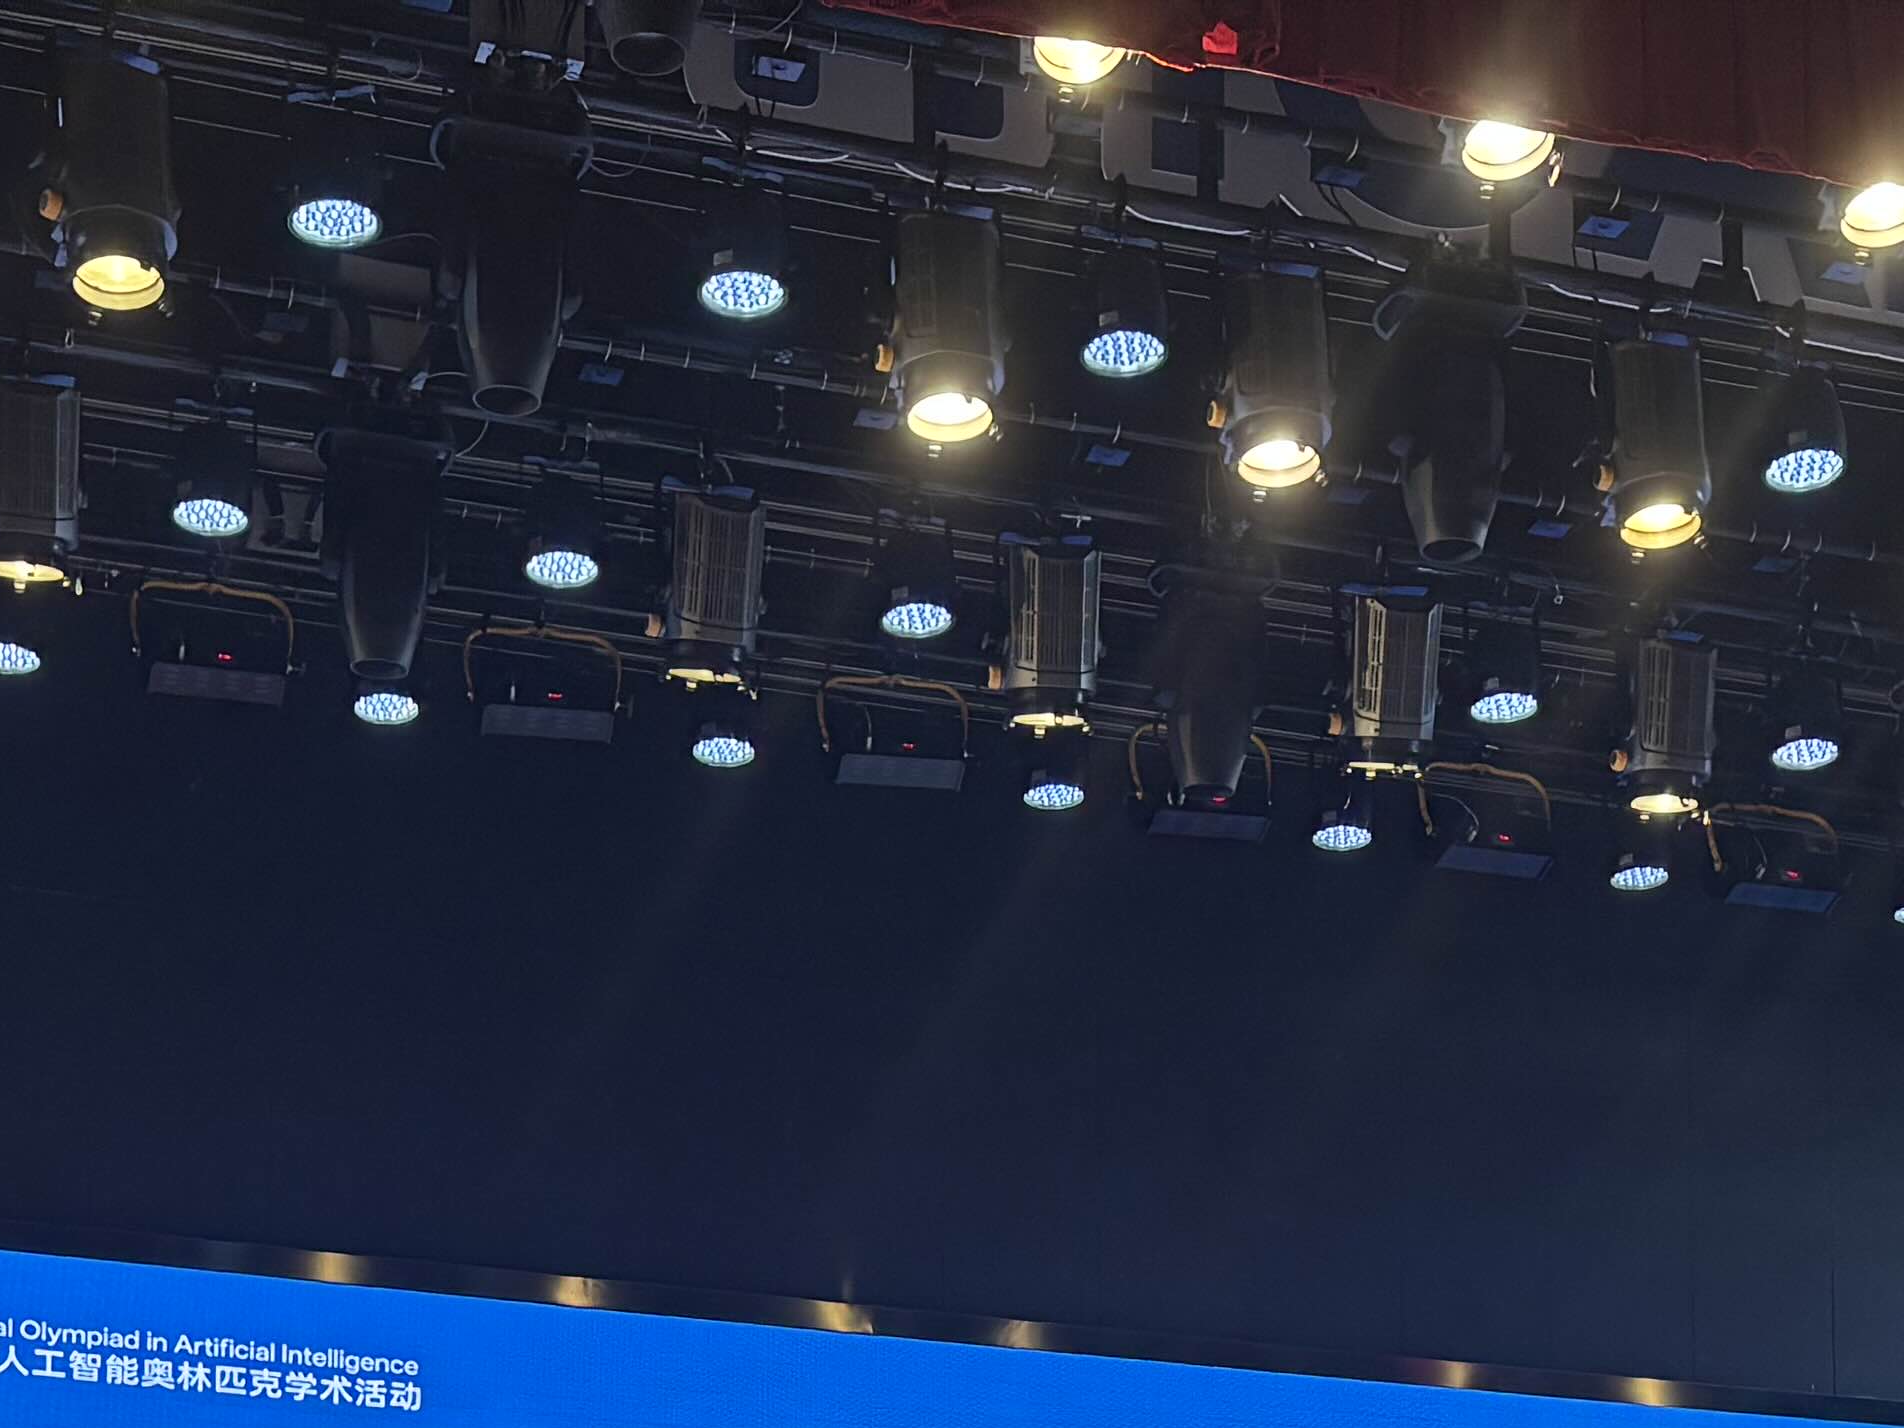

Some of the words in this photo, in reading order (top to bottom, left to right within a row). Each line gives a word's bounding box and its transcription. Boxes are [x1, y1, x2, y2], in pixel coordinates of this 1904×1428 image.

[19, 1319, 140, 1353] Olympiad
[146, 1331, 168, 1353] in
[173, 1334, 277, 1363] Artificial
[281, 1343, 420, 1377] Intelligence
